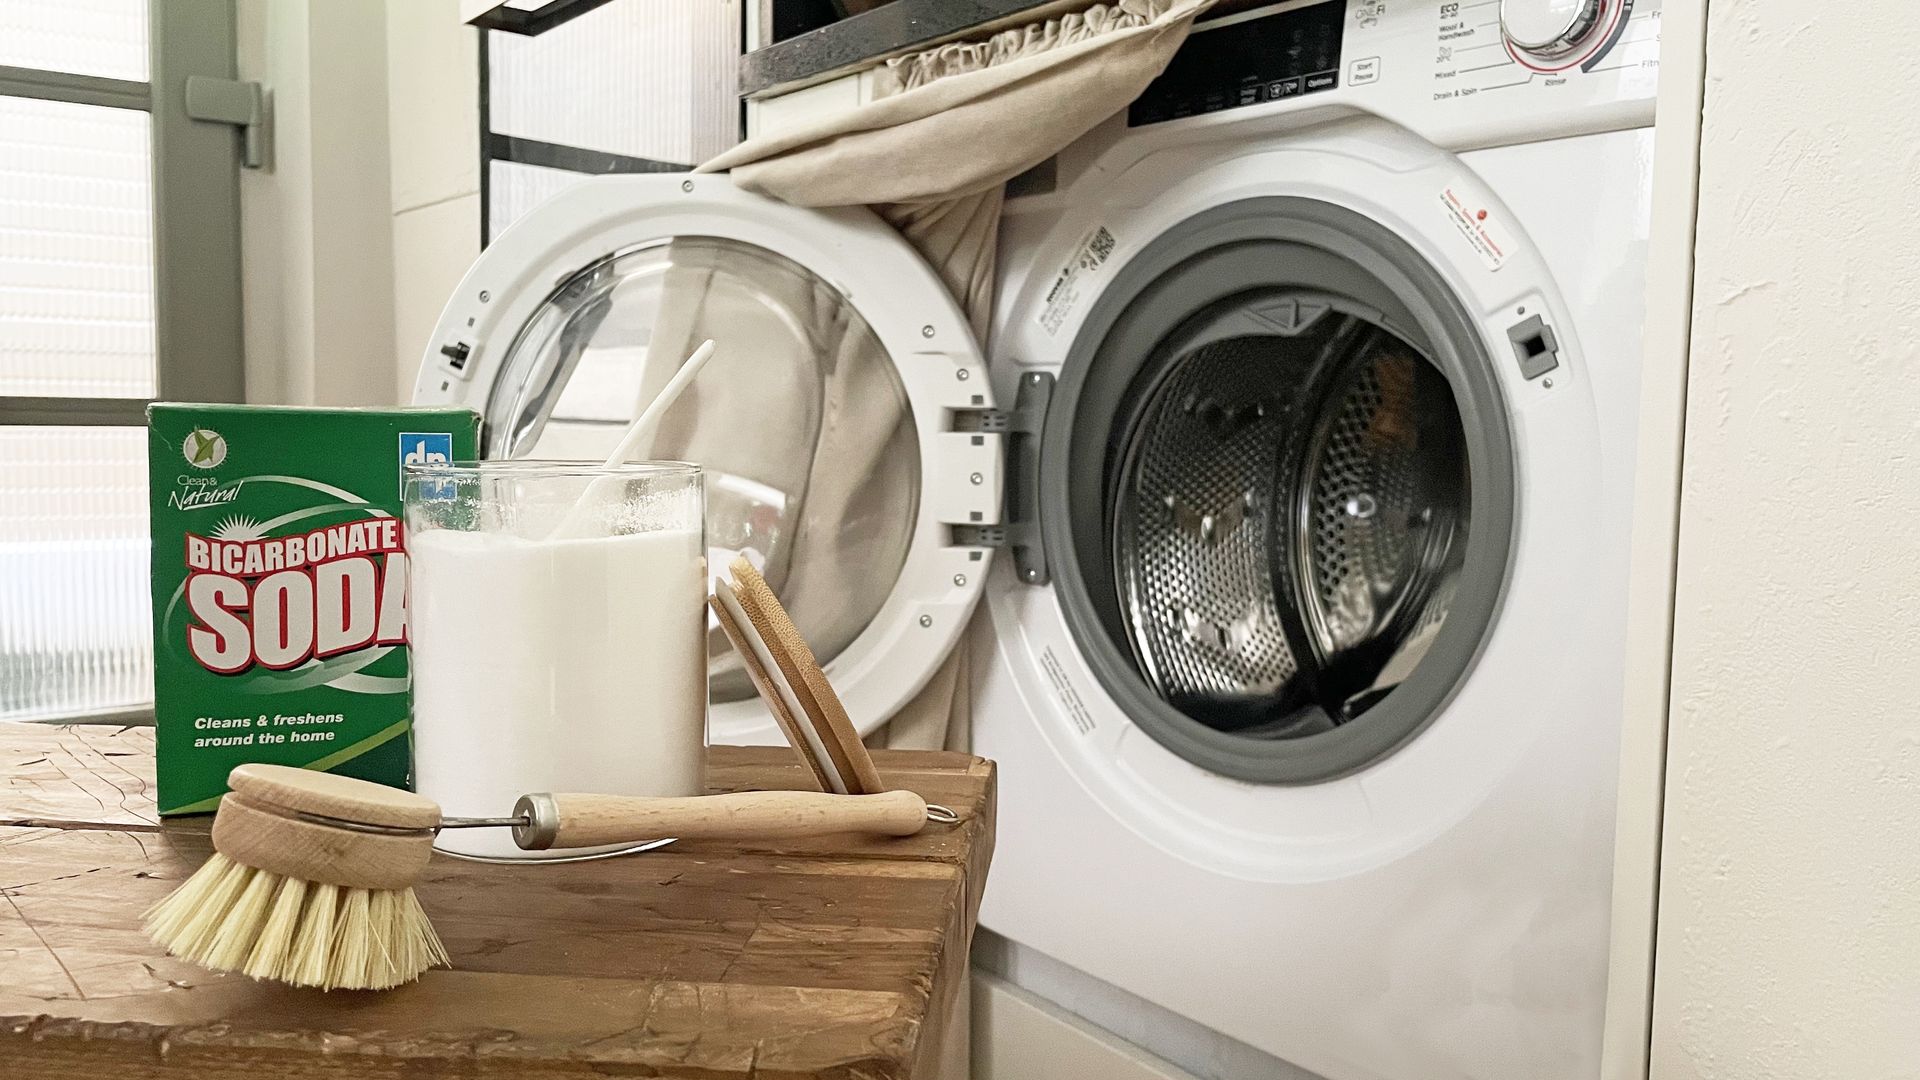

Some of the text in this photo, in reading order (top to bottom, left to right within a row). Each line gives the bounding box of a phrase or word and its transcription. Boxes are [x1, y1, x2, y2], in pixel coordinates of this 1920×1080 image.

[1440, 2, 1459, 14] ECO
[1439, 23, 1458, 32] Wool
[1438, 28, 1475, 42] Handwash
[1357, 62, 1373, 71] Start
[1355, 73, 1374, 81] Pause
[1434, 70, 1457, 80] Mixed
[1544, 78, 1567, 87] Rinse
[1433, 91, 1452, 101] Drain
[1461, 87, 1477, 97] Spin
[167, 480, 244, 511] Natural
[188, 519, 398, 575] BICARBONATE
[194, 712, 344, 730] Cleans & freshens
[194, 730, 335, 748] around the home
